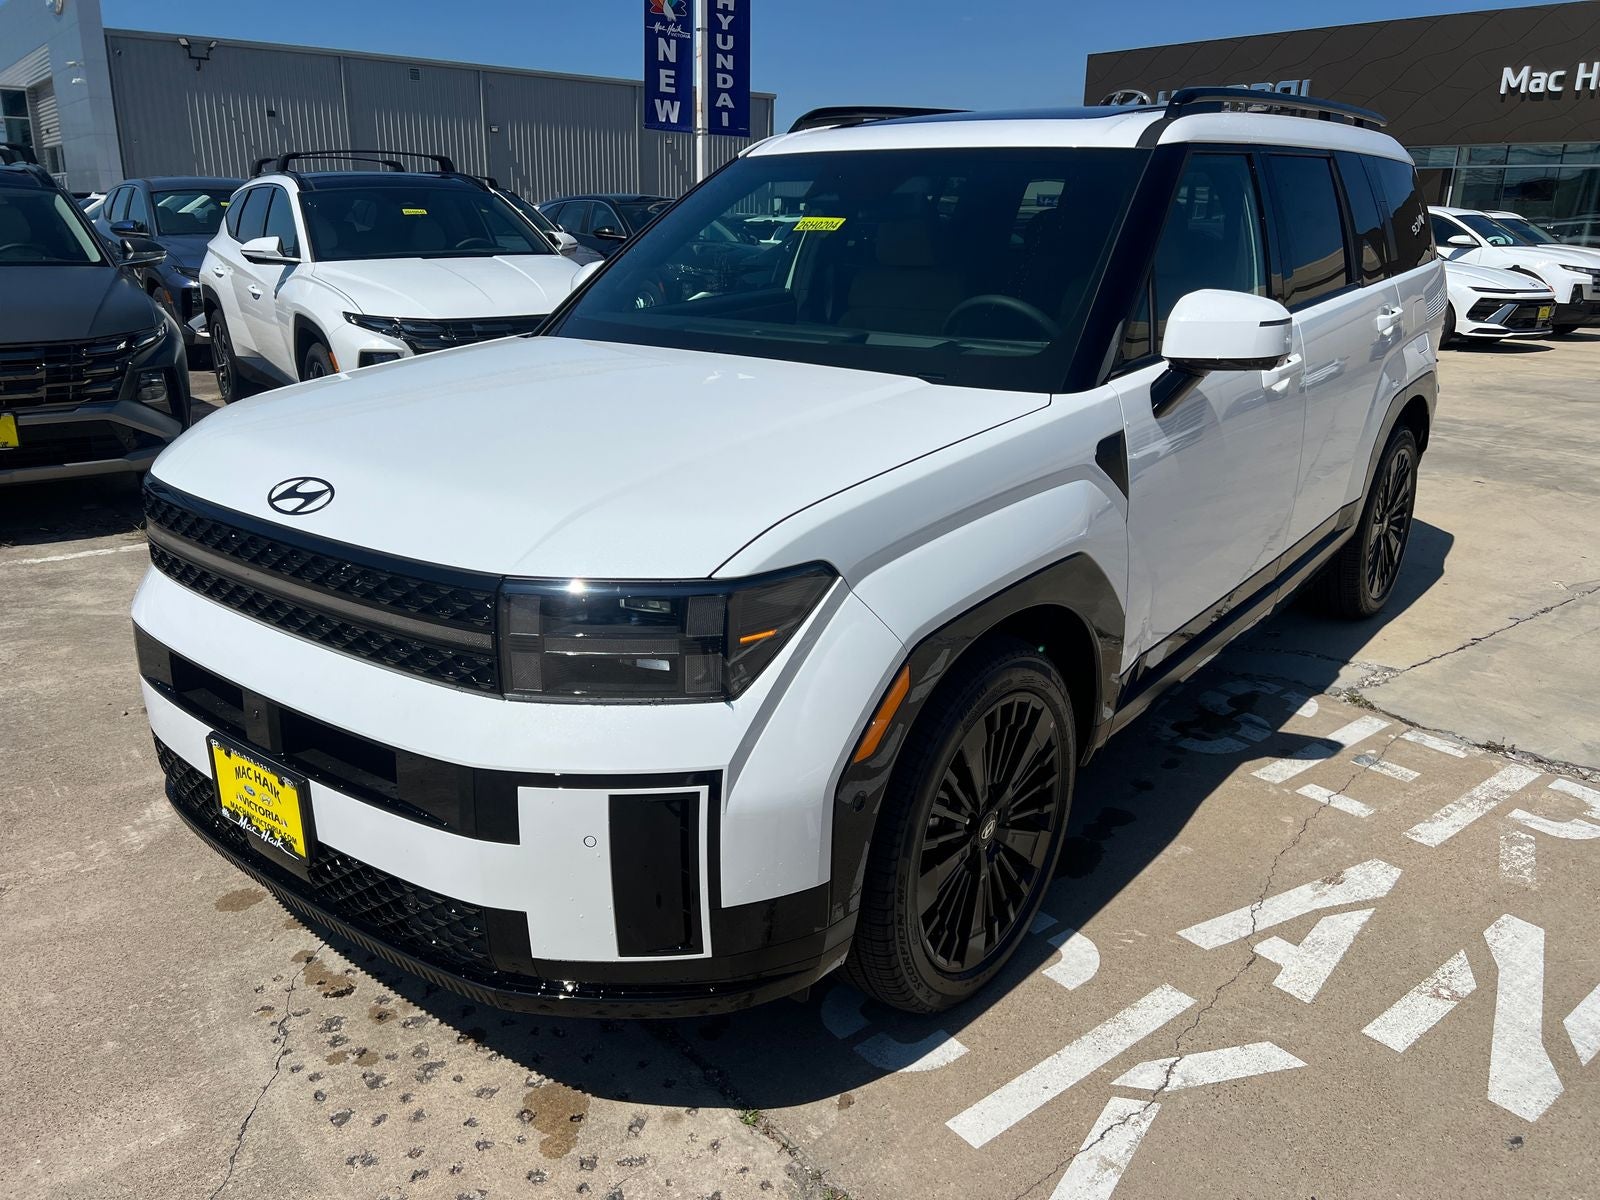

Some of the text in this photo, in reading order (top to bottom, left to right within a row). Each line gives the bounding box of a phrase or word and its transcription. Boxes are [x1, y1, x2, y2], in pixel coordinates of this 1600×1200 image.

[716, 0, 735, 127] HYUNDAI
[1500, 61, 1600, 94] Mac H
[655, 37, 681, 124] NEW
[796, 220, 841, 230] 26H0204
[234, 765, 252, 780] MAC
[253, 769, 281, 804] HAIK
[242, 795, 281, 825] VICTORIA
[238, 815, 286, 848] Mac Haik
